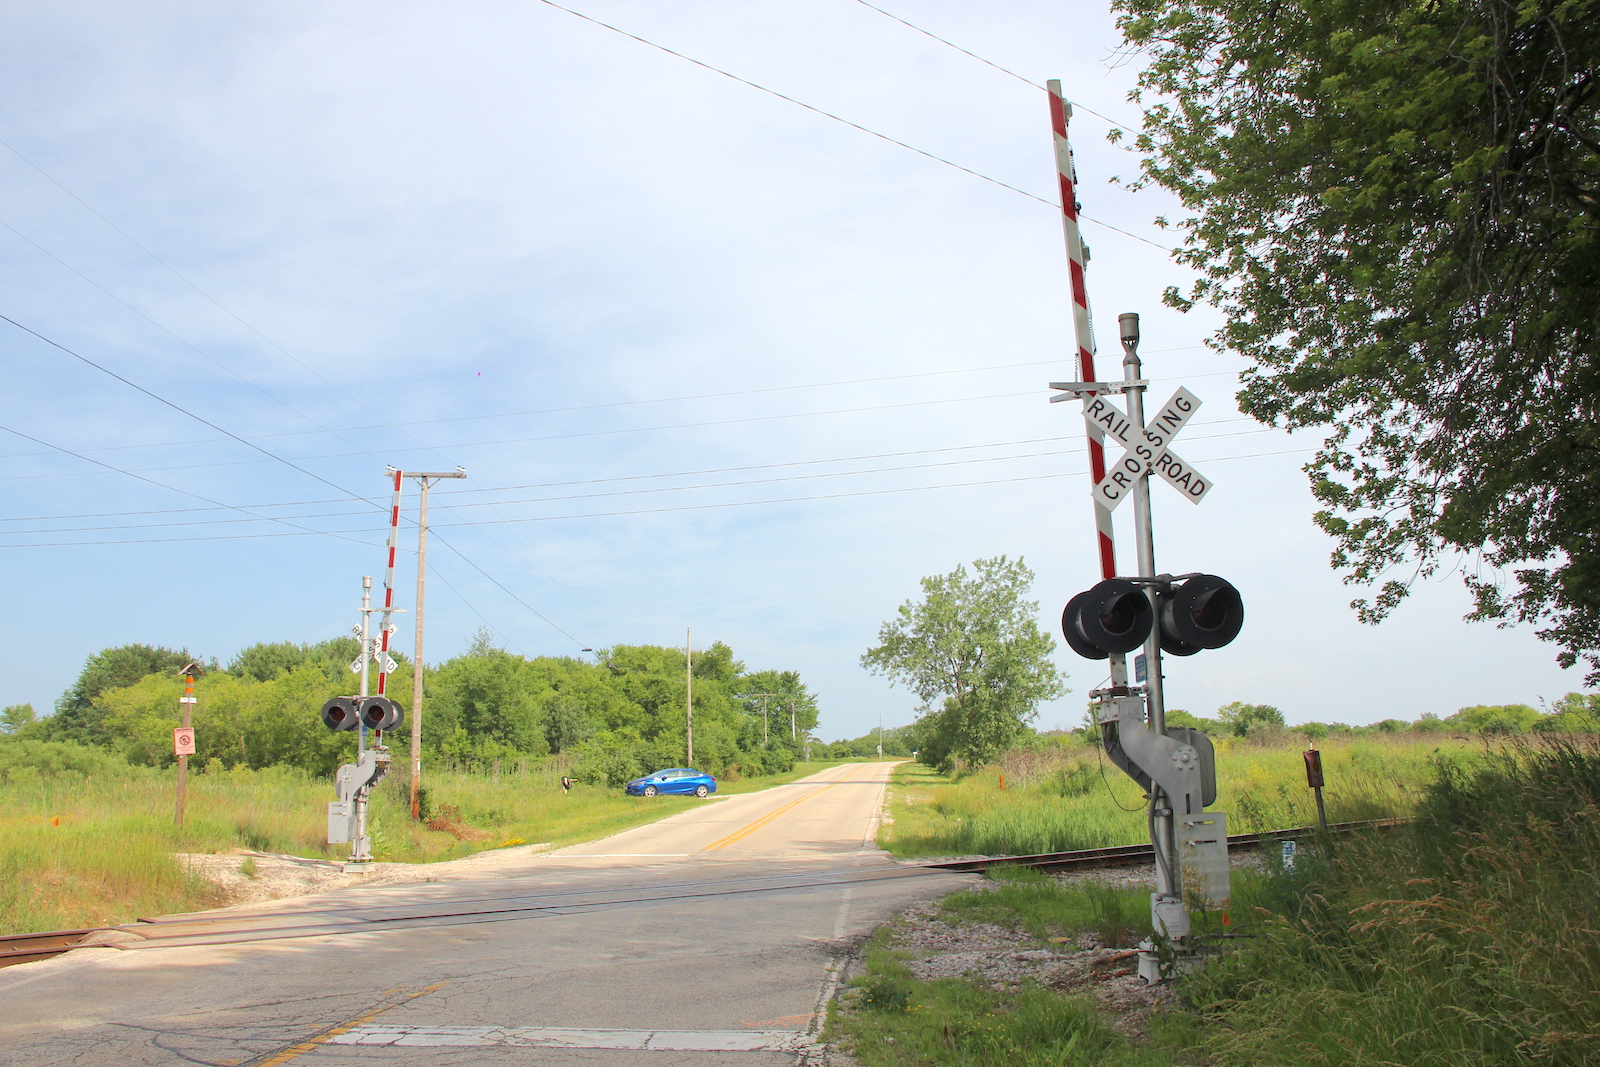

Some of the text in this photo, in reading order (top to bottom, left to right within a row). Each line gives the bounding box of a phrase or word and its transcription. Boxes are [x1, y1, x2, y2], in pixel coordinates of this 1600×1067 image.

[1087, 399, 1205, 496] RAIL ROAD
[1102, 397, 1191, 500] CROSSING
